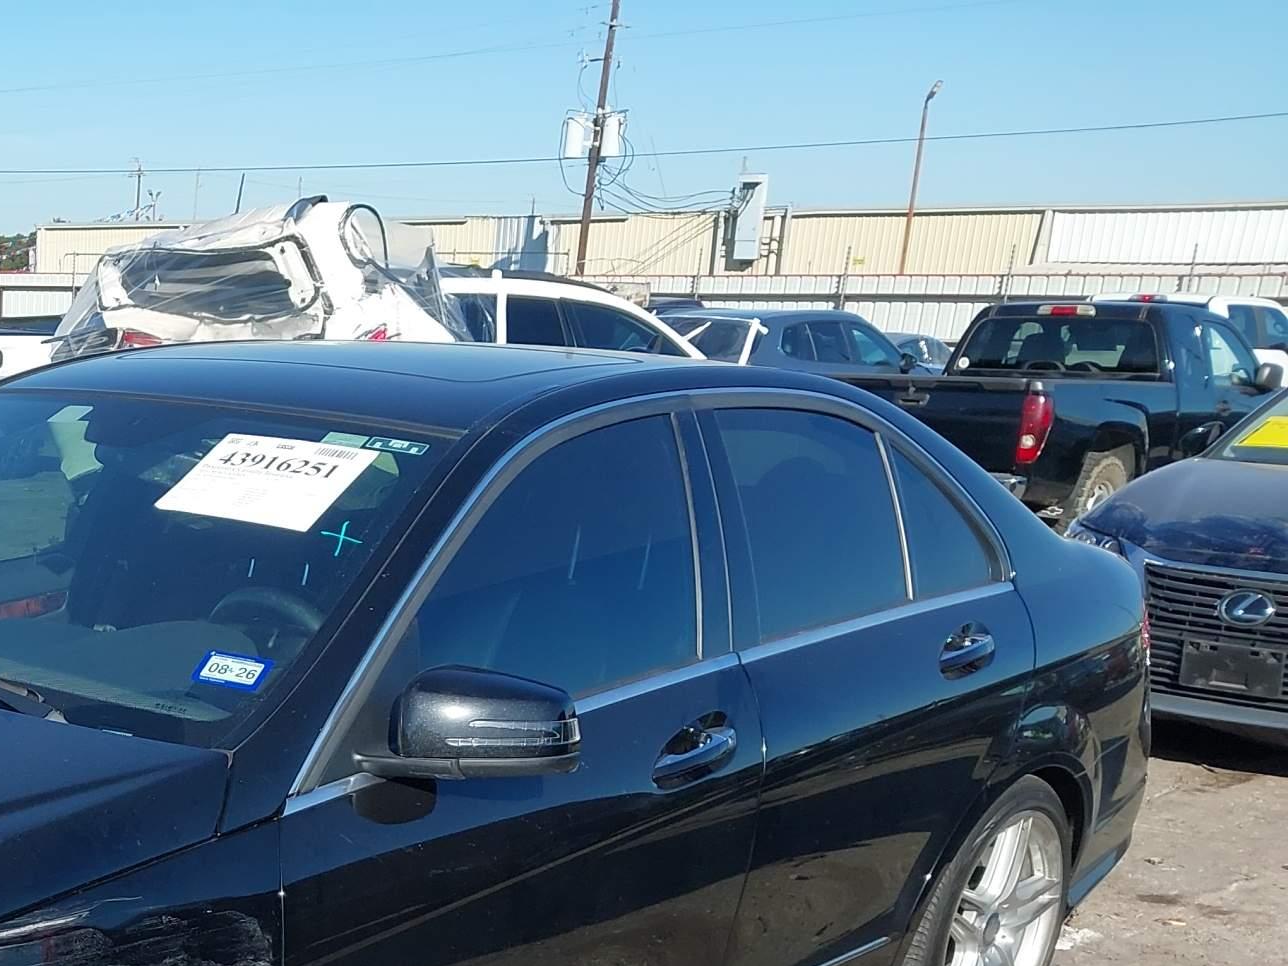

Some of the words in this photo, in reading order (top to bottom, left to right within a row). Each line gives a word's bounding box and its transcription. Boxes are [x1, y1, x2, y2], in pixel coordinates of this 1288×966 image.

[218, 450, 339, 479] 43916251
[208, 662, 229, 675] 08
[235, 667, 258, 680] 26
